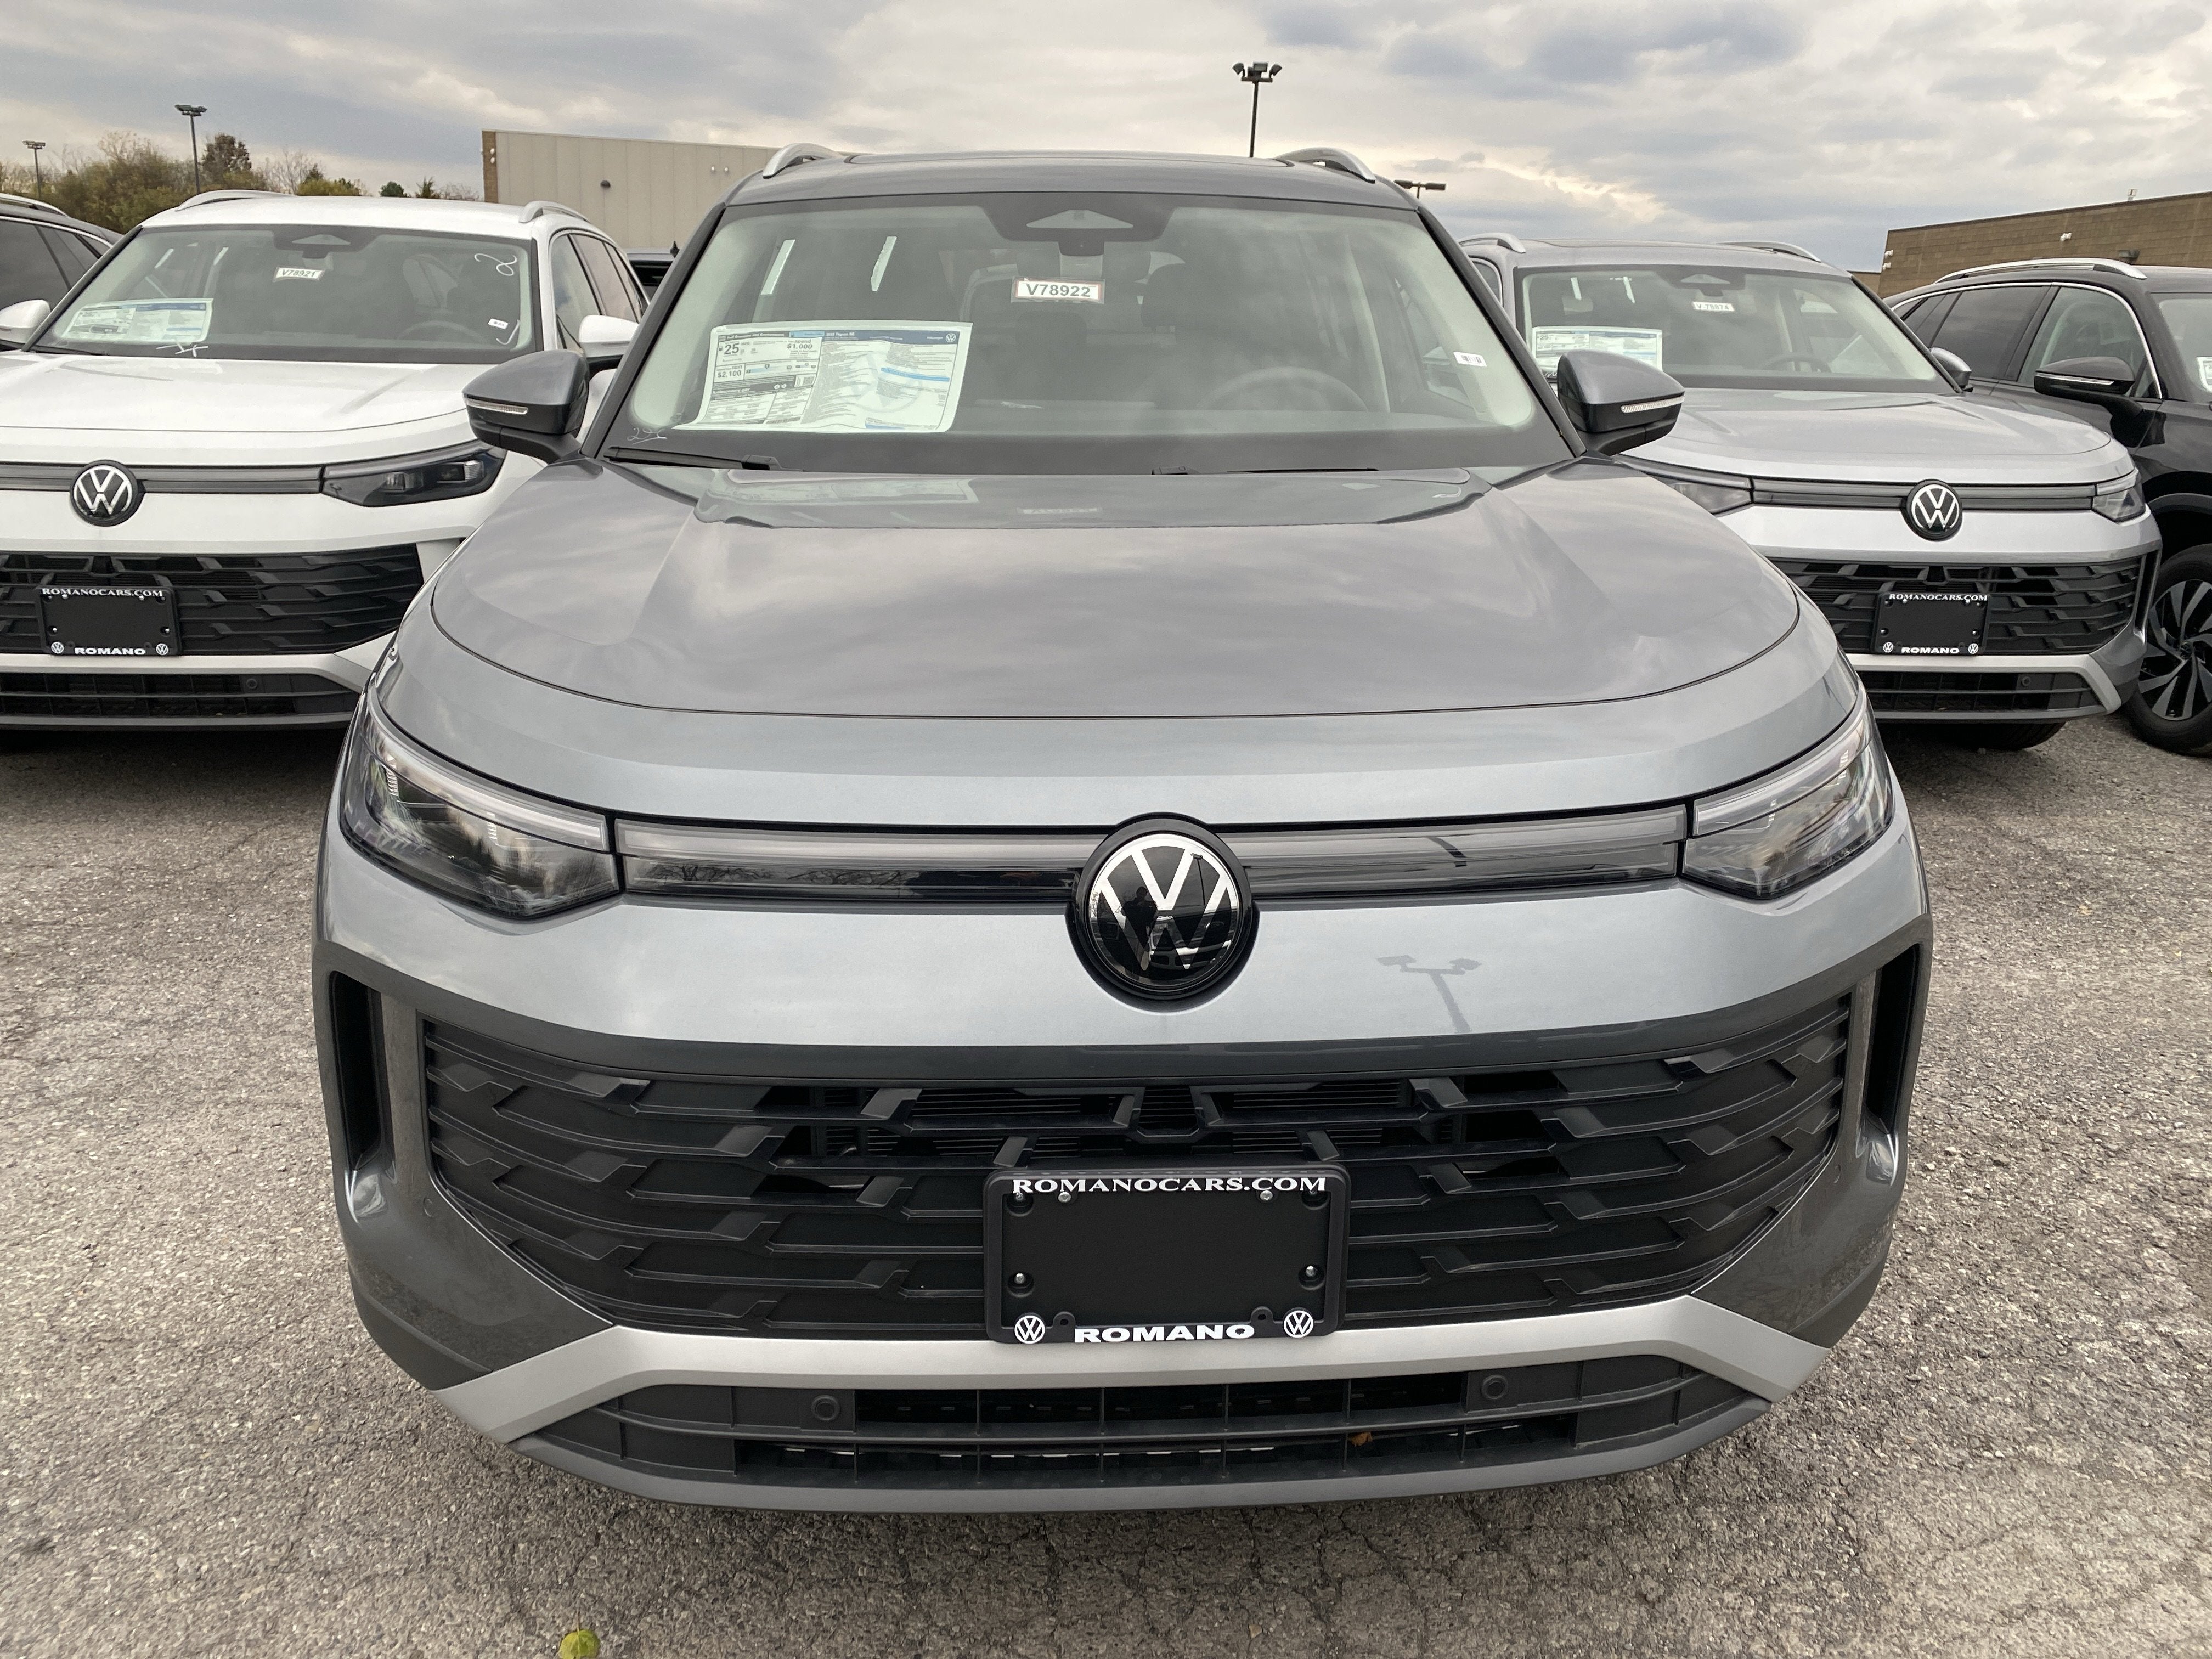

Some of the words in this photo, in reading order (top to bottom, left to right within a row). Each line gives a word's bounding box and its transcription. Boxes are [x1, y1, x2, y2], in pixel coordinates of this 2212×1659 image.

[282, 269, 316, 277] V78921
[1026, 283, 1091, 297] V78922
[724, 343, 740, 355] 25
[717, 370, 742, 378] $2,100
[42, 588, 163, 597] ROMANOCARS.COM
[74, 647, 146, 655] ROMANO
[1012, 1177, 1327, 1194] ROMANOCARS.COM
[1074, 1324, 1255, 1344] ROMANO
